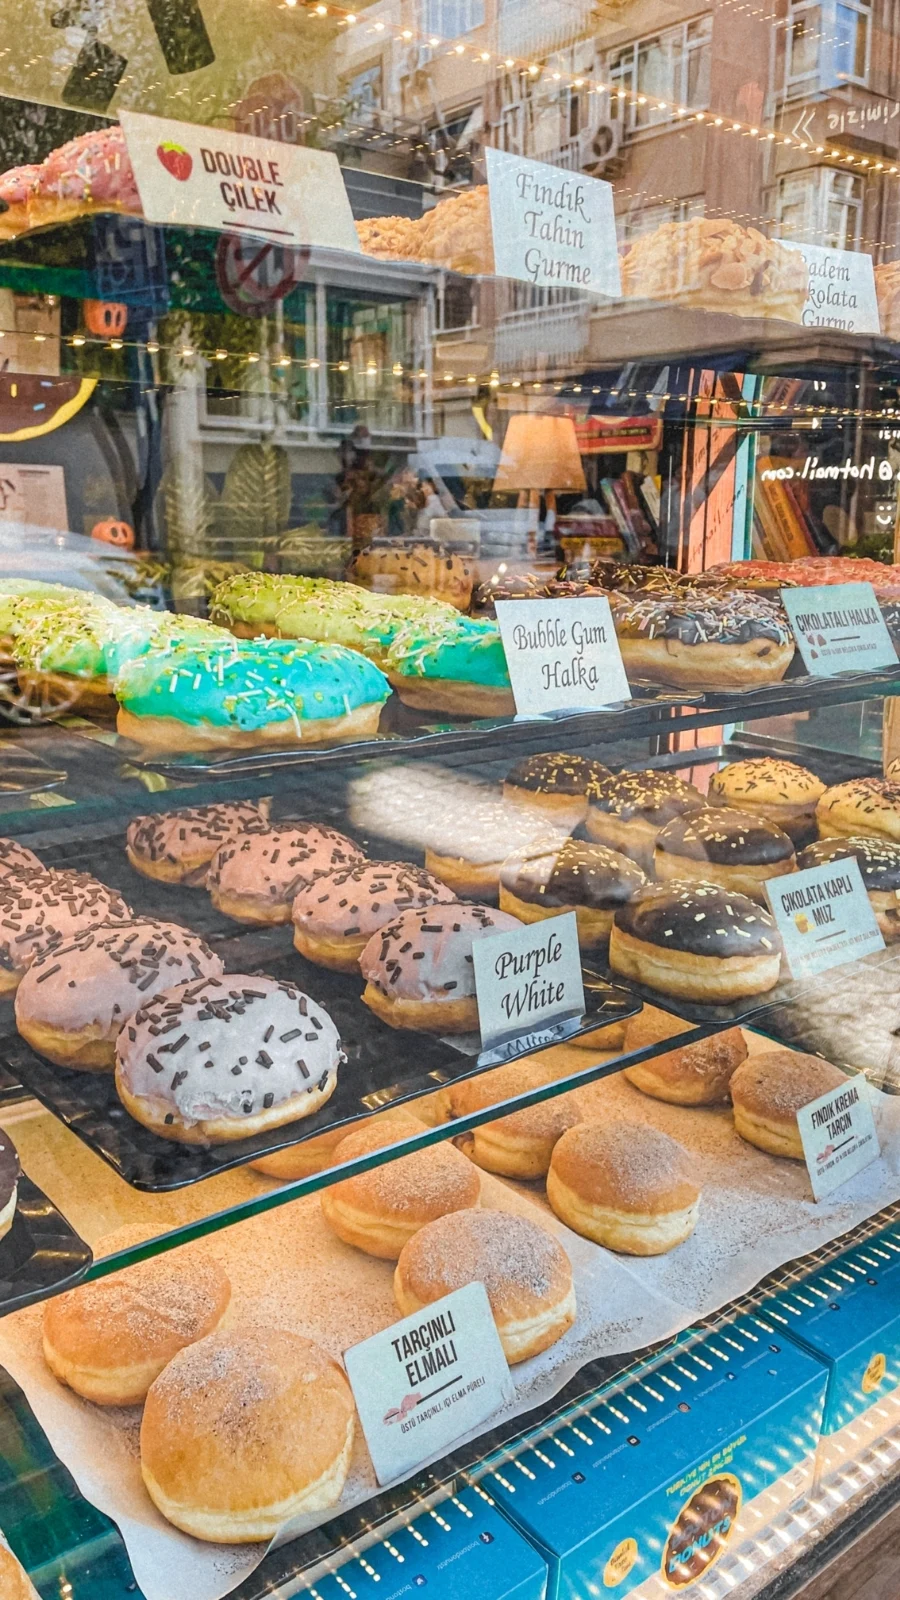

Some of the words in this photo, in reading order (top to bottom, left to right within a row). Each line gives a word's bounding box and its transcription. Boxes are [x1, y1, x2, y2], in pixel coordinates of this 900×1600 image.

[200, 148, 284, 187] DOUBLE
[524, 210, 584, 249] Tahin
[525, 248, 591, 284] Gurme
[802, 255, 850, 281] adem
[808, 280, 858, 309] kolata
[848, 607, 880, 627] HALKA
[513, 618, 567, 650] Bubble
[571, 621, 607, 654] Gum
[541, 657, 599, 691] Halka
[824, 875, 853, 899] KAPLI
[812, 904, 836, 926] MUZ
[495, 933, 562, 980] Purple
[501, 979, 565, 1020] White
[811, 1101, 836, 1130] FINDIK
[834, 1087, 860, 1114] KREMA
[826, 1111, 853, 1141] TARÇIN
[391, 1310, 456, 1362] TARÇINLI
[405, 1340, 458, 1388] ELMALI
[451, 1388, 467, 1403] ELMA
